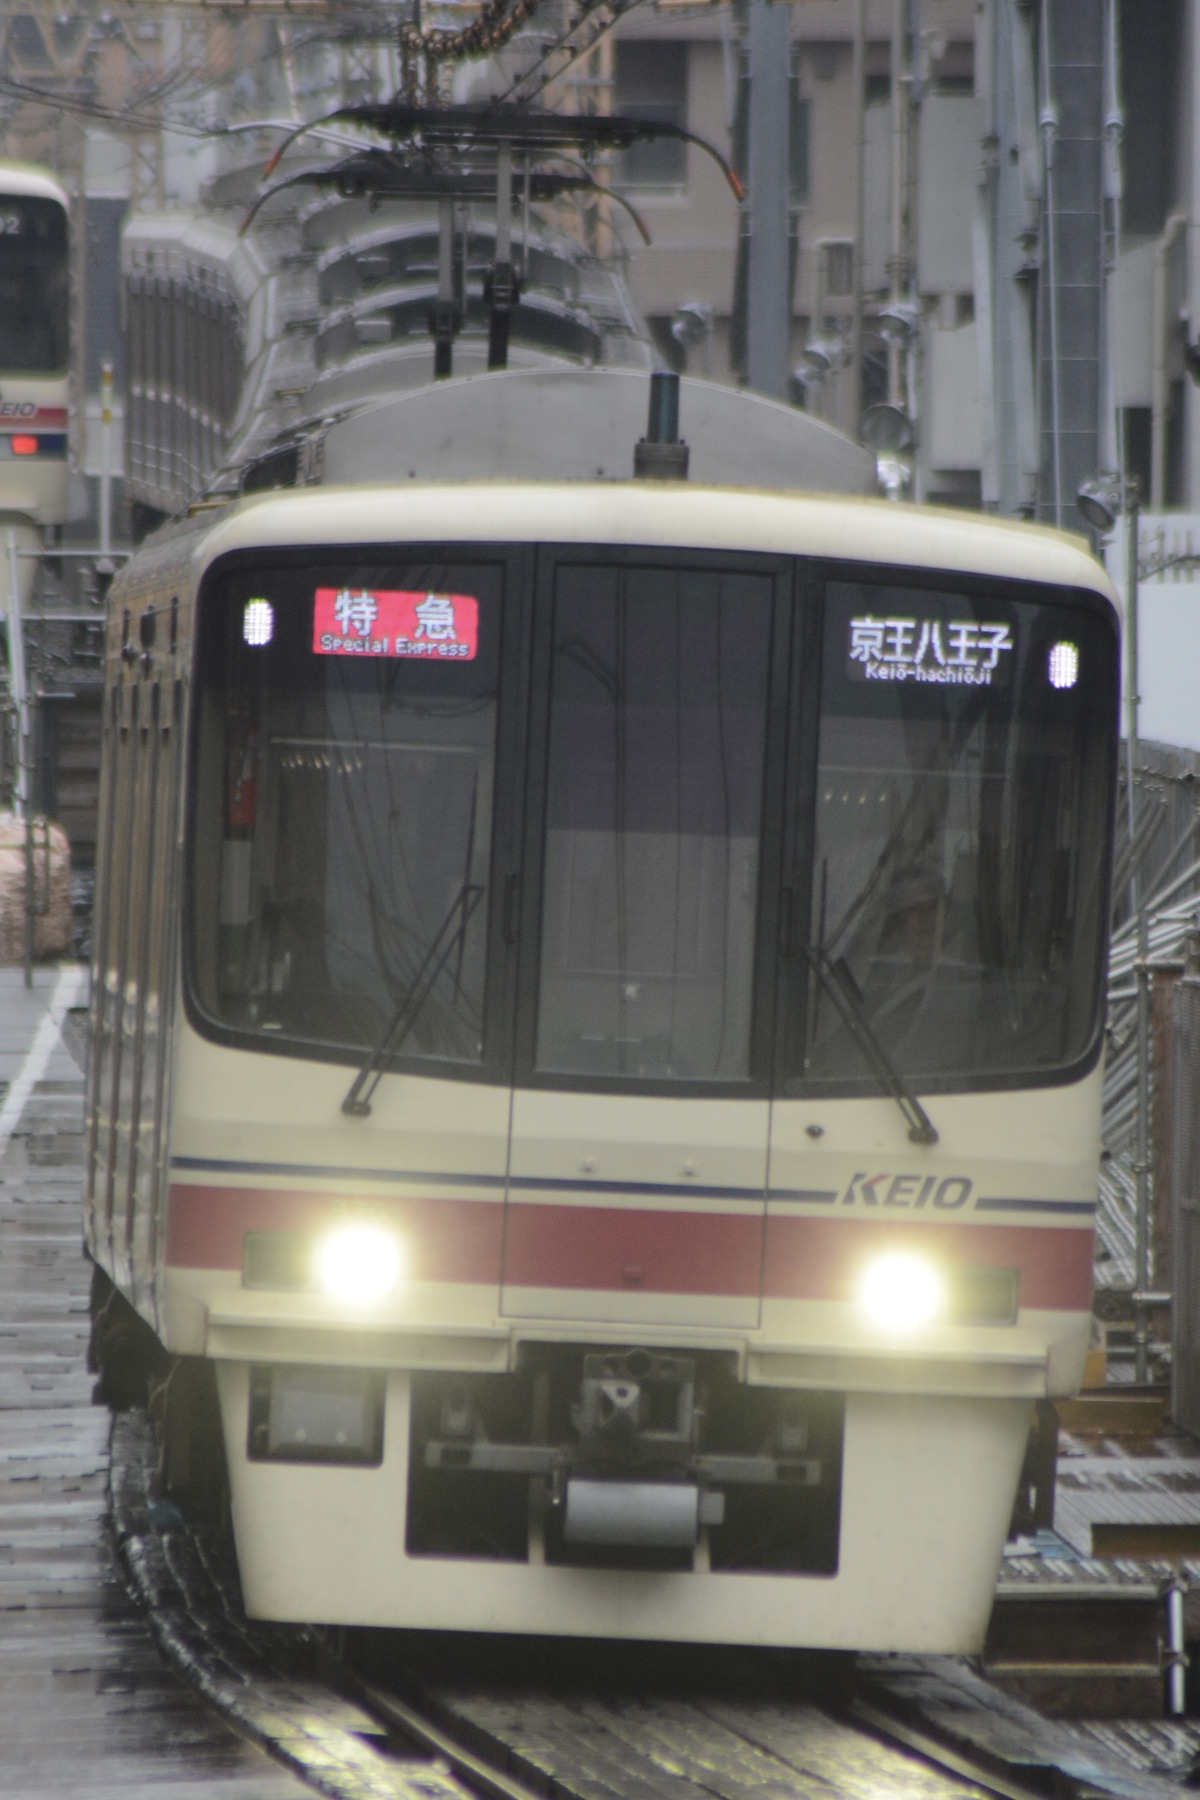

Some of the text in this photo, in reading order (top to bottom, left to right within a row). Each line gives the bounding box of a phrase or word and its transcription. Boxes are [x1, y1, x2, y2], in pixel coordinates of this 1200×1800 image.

[334, 589, 457, 639] 特急
[320, 634, 469, 656] Special Express
[849, 615, 1013, 668] 京王八王子
[842, 1172, 973, 1210] KEIO
